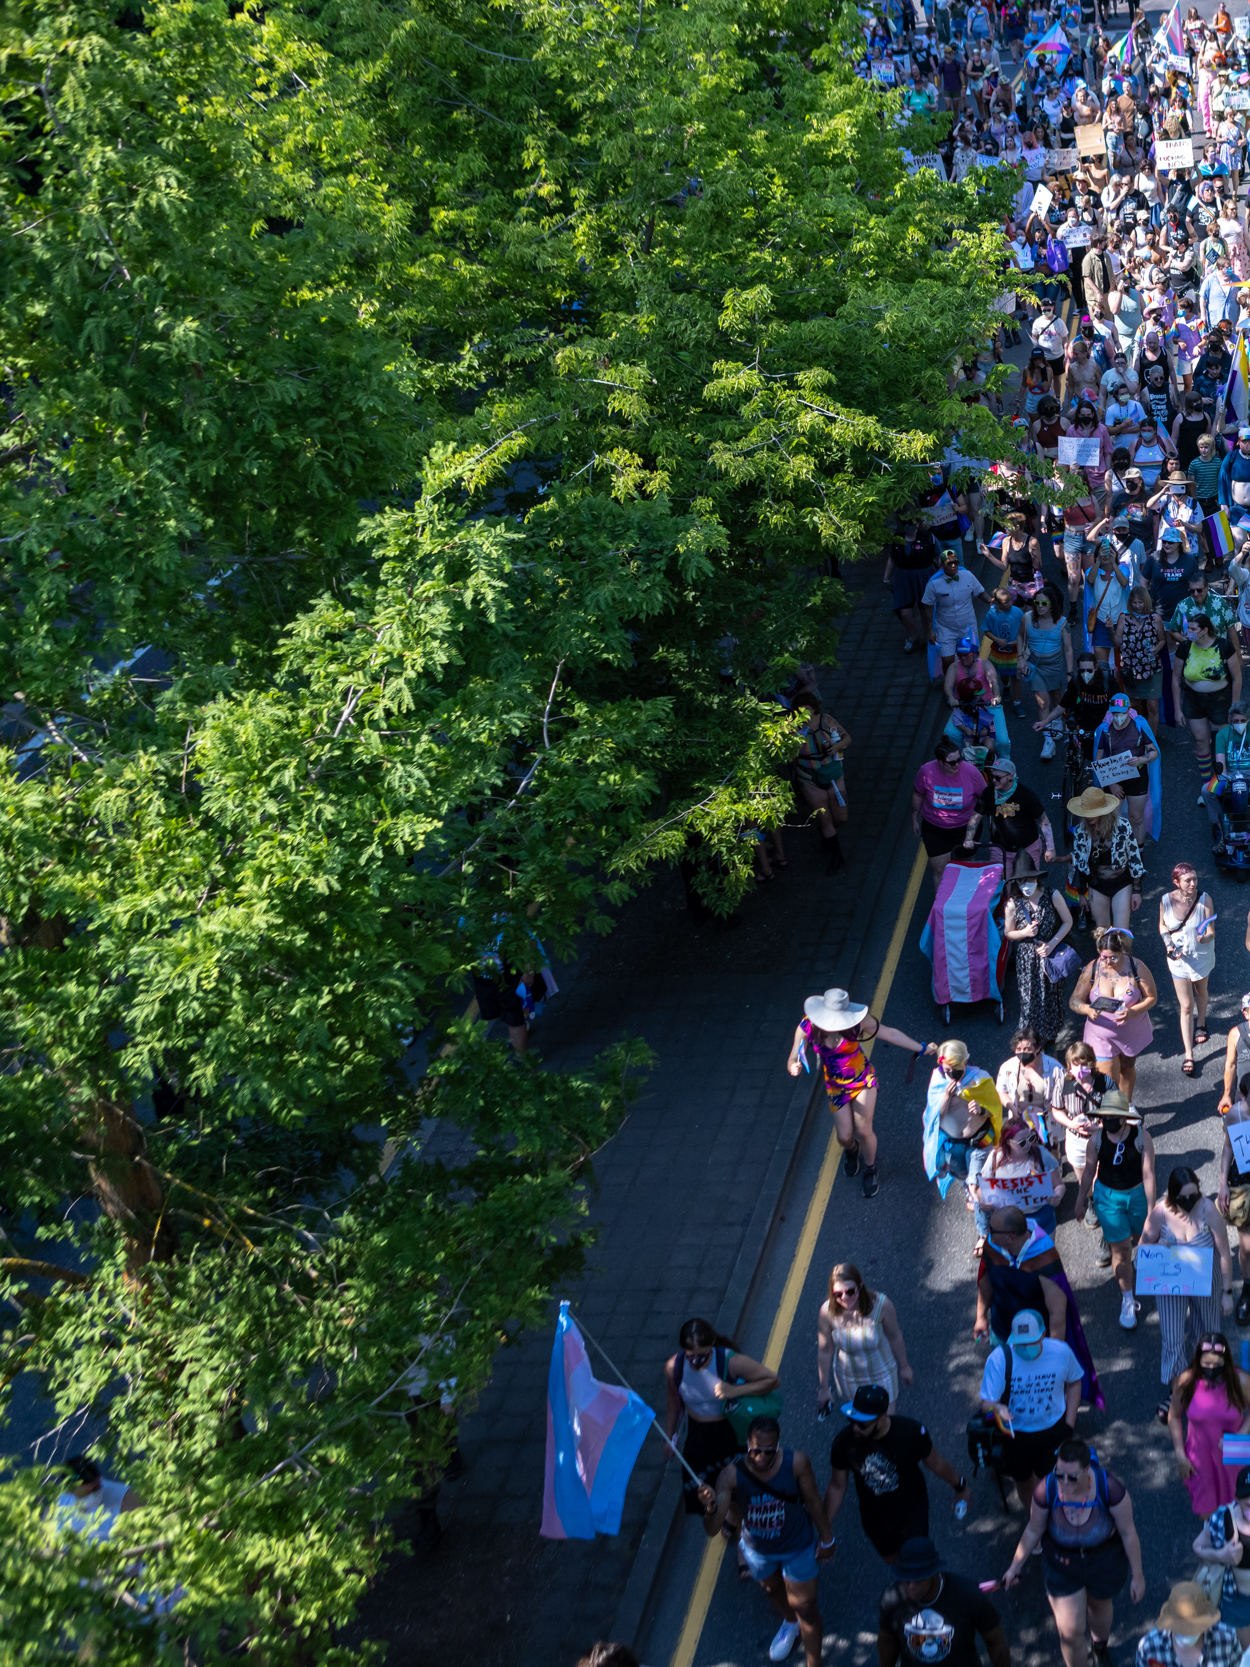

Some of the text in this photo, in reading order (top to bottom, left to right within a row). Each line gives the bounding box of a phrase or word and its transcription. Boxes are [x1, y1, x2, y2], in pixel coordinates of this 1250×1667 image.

[913, 156, 937, 166] TRANS
[984, 1173, 1047, 1190] RESIST
[1007, 1187, 1030, 1195] THE
[1140, 1248, 1163, 1259] Non
[1158, 1262, 1182, 1277] IS
